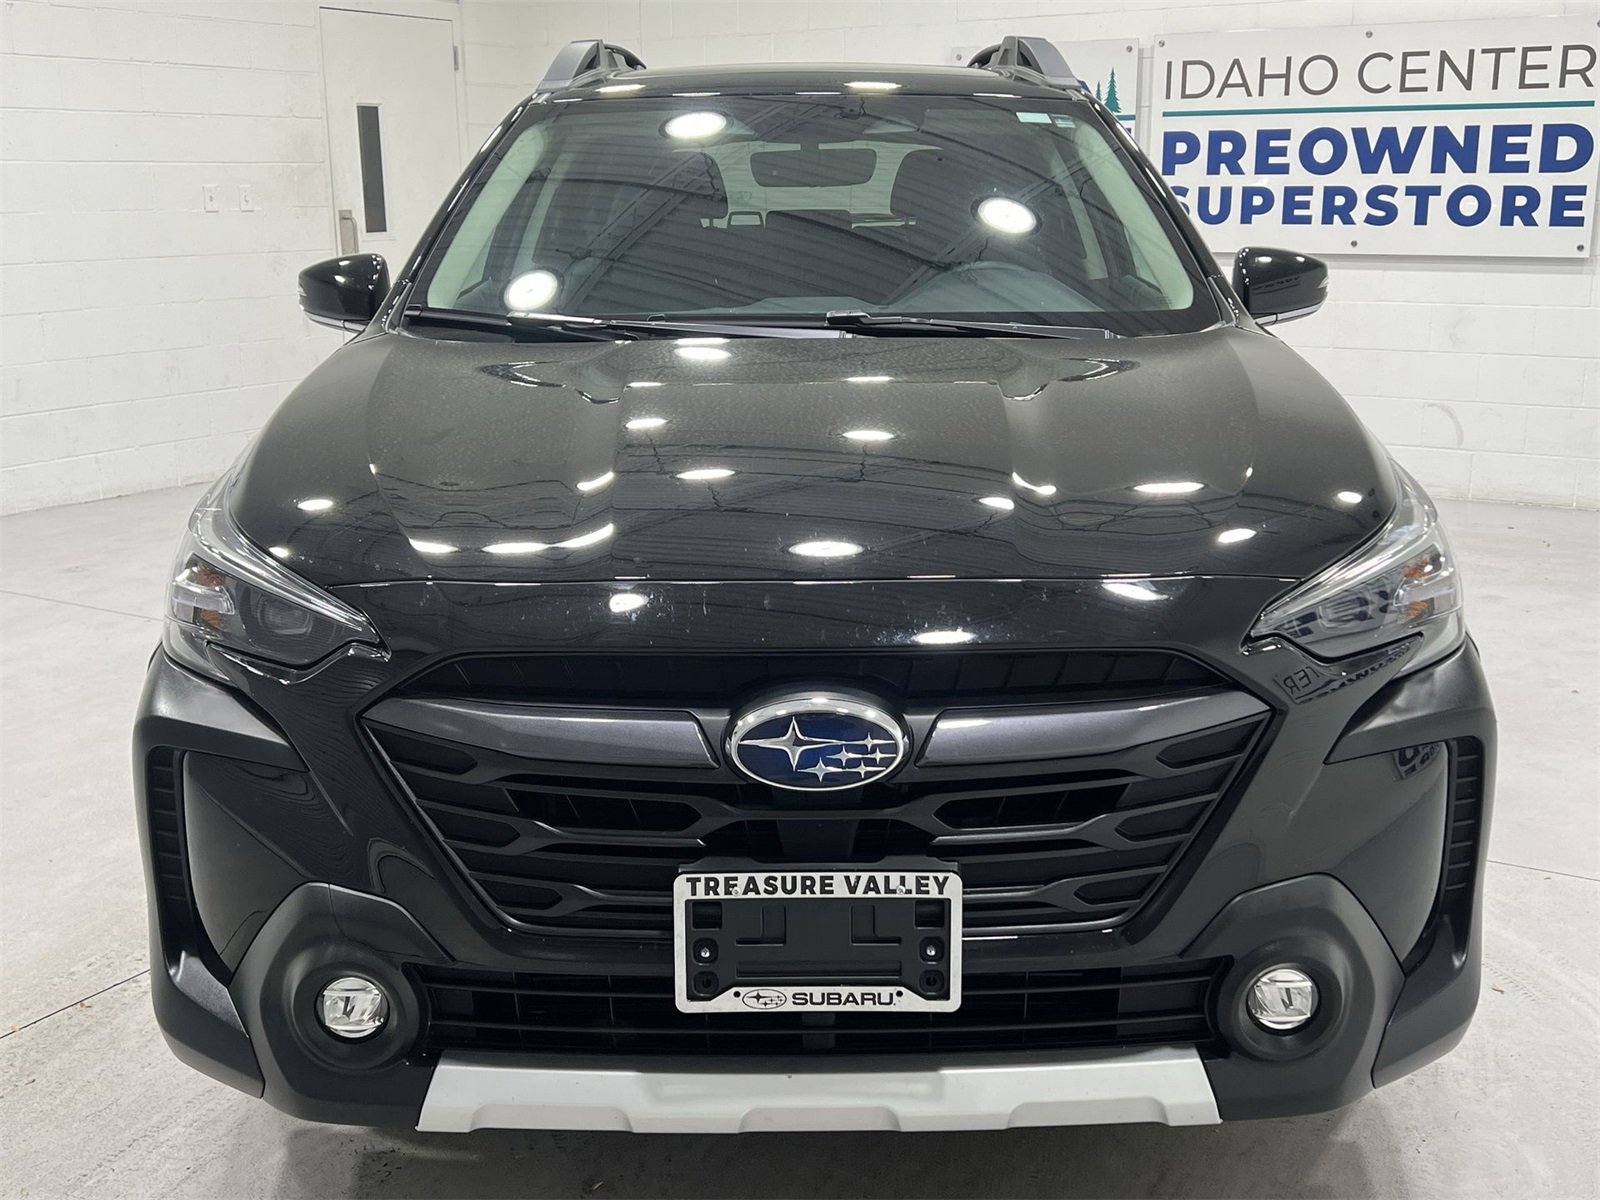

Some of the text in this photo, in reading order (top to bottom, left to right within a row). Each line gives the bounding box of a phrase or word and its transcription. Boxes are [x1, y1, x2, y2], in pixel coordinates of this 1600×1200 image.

[1164, 44, 1597, 99] IDAHO CENTER
[1163, 124, 1594, 175] PREOWNED
[686, 875, 949, 896] TREASURE VALLEY
[792, 992, 894, 1006] SUBARU
